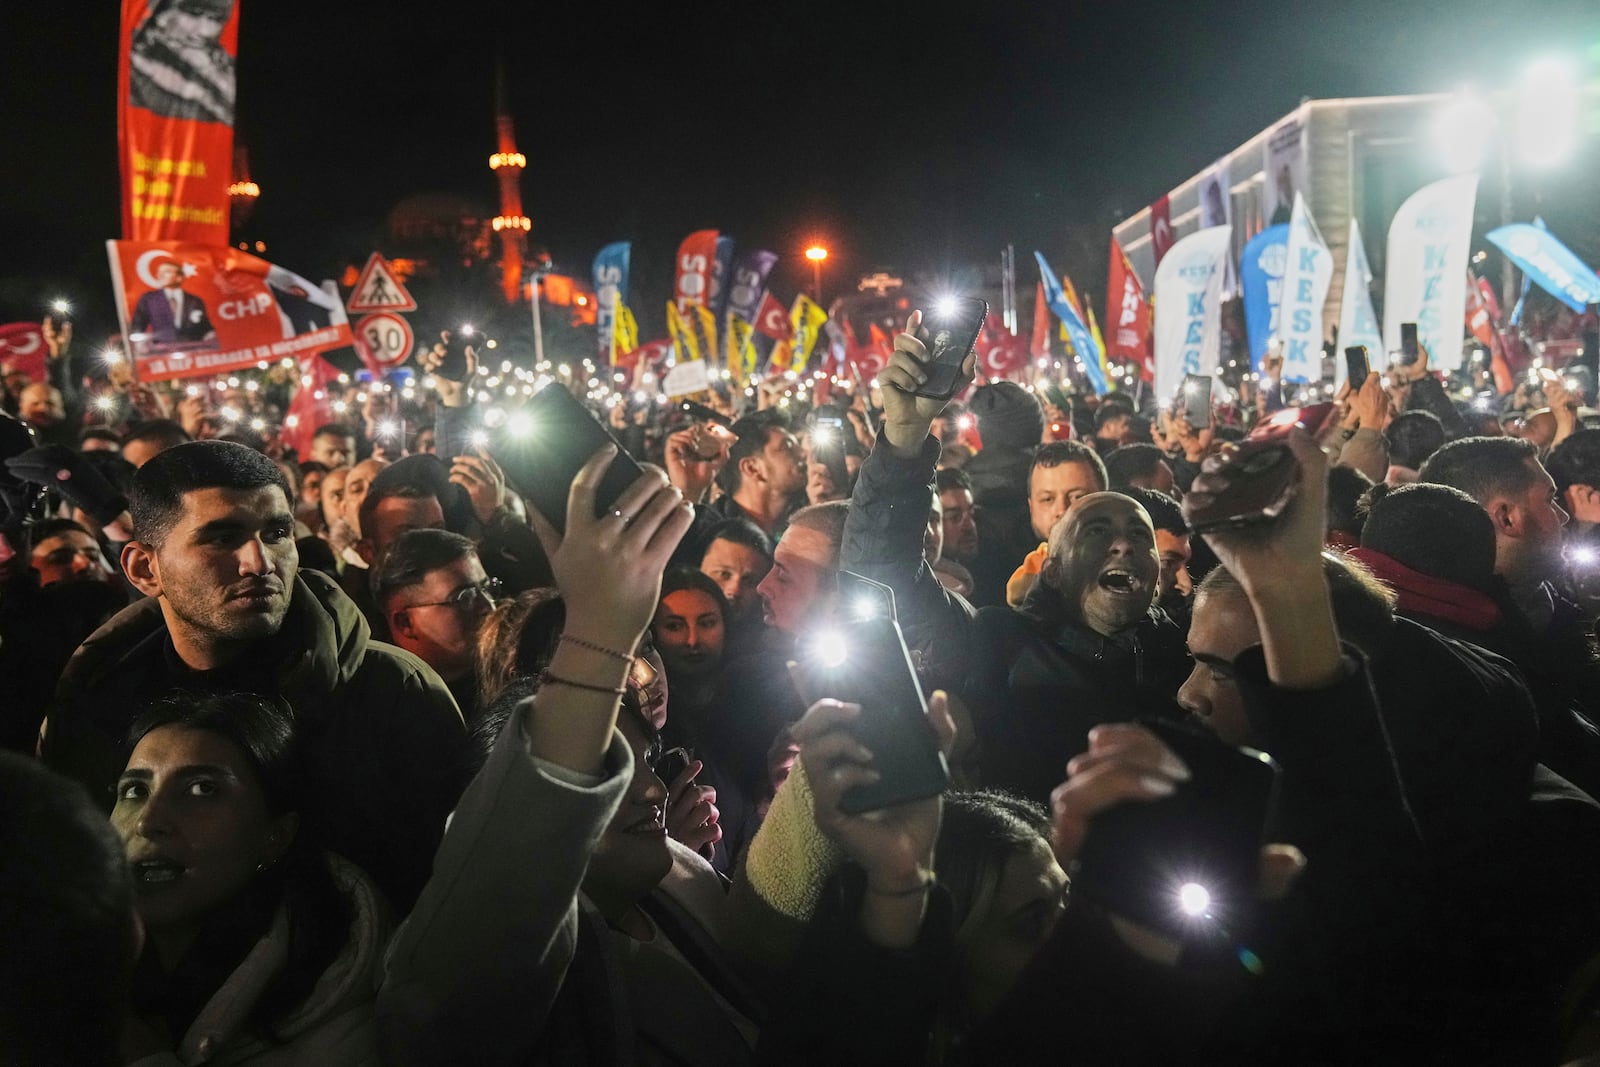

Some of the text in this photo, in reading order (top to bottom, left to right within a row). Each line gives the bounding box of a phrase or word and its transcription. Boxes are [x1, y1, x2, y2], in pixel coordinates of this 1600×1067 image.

[218, 292, 272, 320] CHP
[367, 327, 400, 352] 30
[1184, 292, 1207, 375] KES
[1288, 248, 1319, 363] KESK
[1418, 243, 1448, 364] KESK
